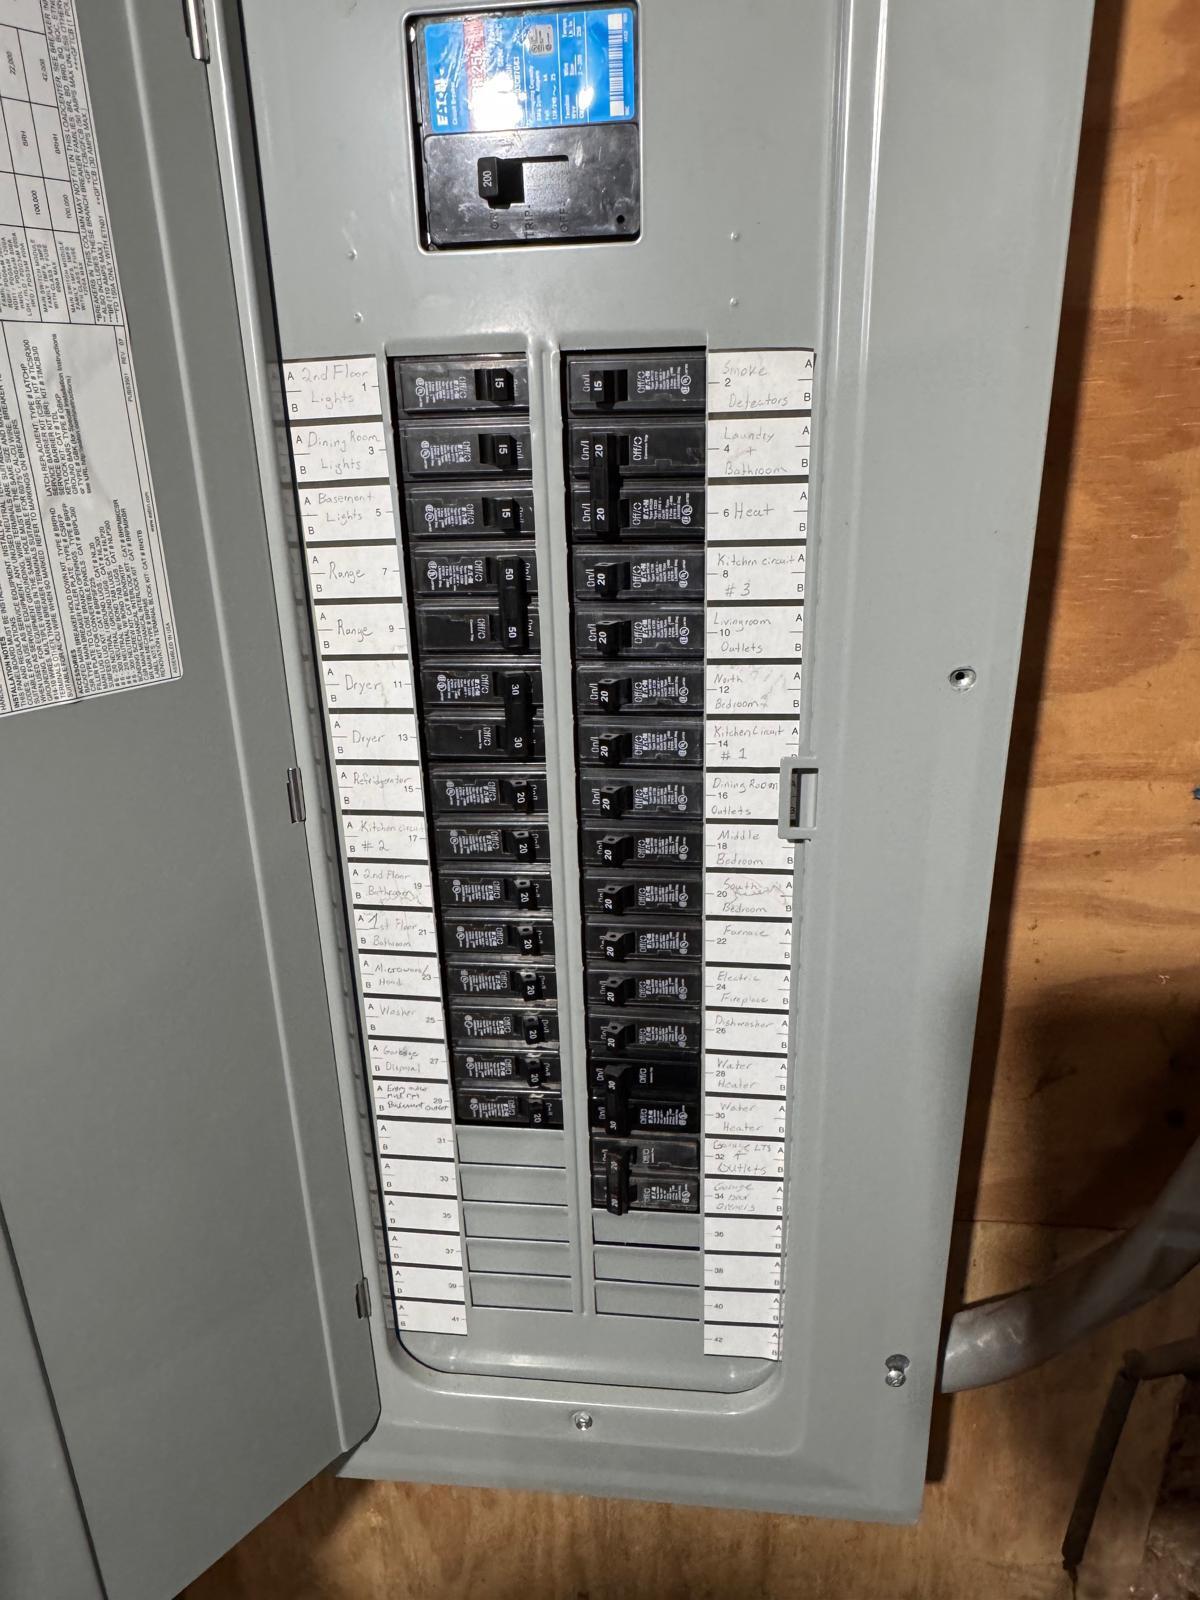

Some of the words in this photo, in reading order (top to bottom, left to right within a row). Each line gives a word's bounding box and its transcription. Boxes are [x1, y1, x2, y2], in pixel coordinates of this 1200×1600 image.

[483, 170, 492, 187] 200
[33, 190, 41, 215] 100,000
[723, 360, 768, 376] Smoke
[805, 359, 813, 368] A
[287, 371, 295, 381] A
[302, 365, 328, 382] 2nd
[333, 363, 368, 380] Floor
[362, 382, 367, 391] 1
[495, 377, 504, 388] 15
[593, 380, 603, 391] 15
[724, 378, 731, 387] 2
[311, 391, 354, 409] Lights
[728, 391, 788, 410] Detectors
[803, 393, 811, 402] B
[291, 403, 299, 413] B
[13, 419, 25, 458] BREAKERS
[723, 426, 775, 443] Laundry
[308, 431, 347, 453] Dining
[350, 430, 379, 442] Room
[368, 446, 374, 455] 3
[498, 444, 508, 455] 15
[595, 444, 604, 458] 20
[723, 444, 730, 453] 4
[321, 458, 361, 475] Lights
[725, 461, 789, 476] Bathroom
[318, 491, 374, 504] Basement
[375, 508, 382, 517] 5
[723, 508, 730, 518] 6
[734, 501, 775, 519] Heat
[326, 508, 363, 526] Lights
[59, 514, 67, 537] CSRFP
[312, 555, 319, 564] A
[717, 553, 757, 567] Kitchen
[761, 555, 795, 566] circuit
[797, 554, 805, 562] A
[329, 561, 365, 584] Range
[382, 567, 388, 576] 7
[505, 568, 514, 580] 50
[722, 570, 729, 578] 8
[597, 573, 606, 586] 20
[316, 584, 323, 592] B
[796, 583, 804, 592] B
[337, 618, 374, 643] Range
[389, 625, 394, 633] 9
[508, 626, 517, 639] 50
[720, 628, 731, 637] 10
[1, 637, 9, 659] NOTES
[721, 641, 764, 654] Outlets
[72, 649, 83, 694] ACCESSORIES
[6, 661, 19, 708] INSTALLATION
[344, 674, 382, 695] Dryer
[714, 673, 743, 684] North
[511, 684, 520, 696] 30
[719, 686, 730, 694] 12
[398, 733, 408, 742] 13
[713, 725, 751, 738] Kitchen
[352, 729, 385, 748] Dryer
[404, 785, 414, 793] 15
[712, 777, 746, 793] Dining
[749, 778, 778, 790] Room
[516, 792, 525, 804] 20
[602, 798, 611, 810] 20
[711, 804, 752, 815] Outlets
[360, 820, 397, 832] Kitchen
[717, 830, 760, 841] Middle
[716, 852, 764, 865] Bedroom
[363, 868, 383, 880] 2nd
[723, 877, 758, 891] South
[717, 890, 728, 898] 20
[722, 902, 767, 913] Bedroom
[723, 924, 769, 937] Furnace
[524, 939, 532, 950] 20
[716, 937, 727, 945] 22
[606, 946, 615, 957] 20
[717, 971, 760, 982] Electric
[716, 983, 726, 991] 24
[720, 992, 769, 1006] Fireplace
[380, 1004, 416, 1016] Washer
[715, 1014, 774, 1028] Dishwasher
[717, 1057, 752, 1070] Water
[608, 1080, 617, 1090] 30
[717, 1079, 756, 1089] Heater
[720, 1102, 756, 1112] Water
[534, 1113, 542, 1124] 20
[723, 1121, 763, 1132] Heater
[718, 1162, 767, 1175] Outlets
